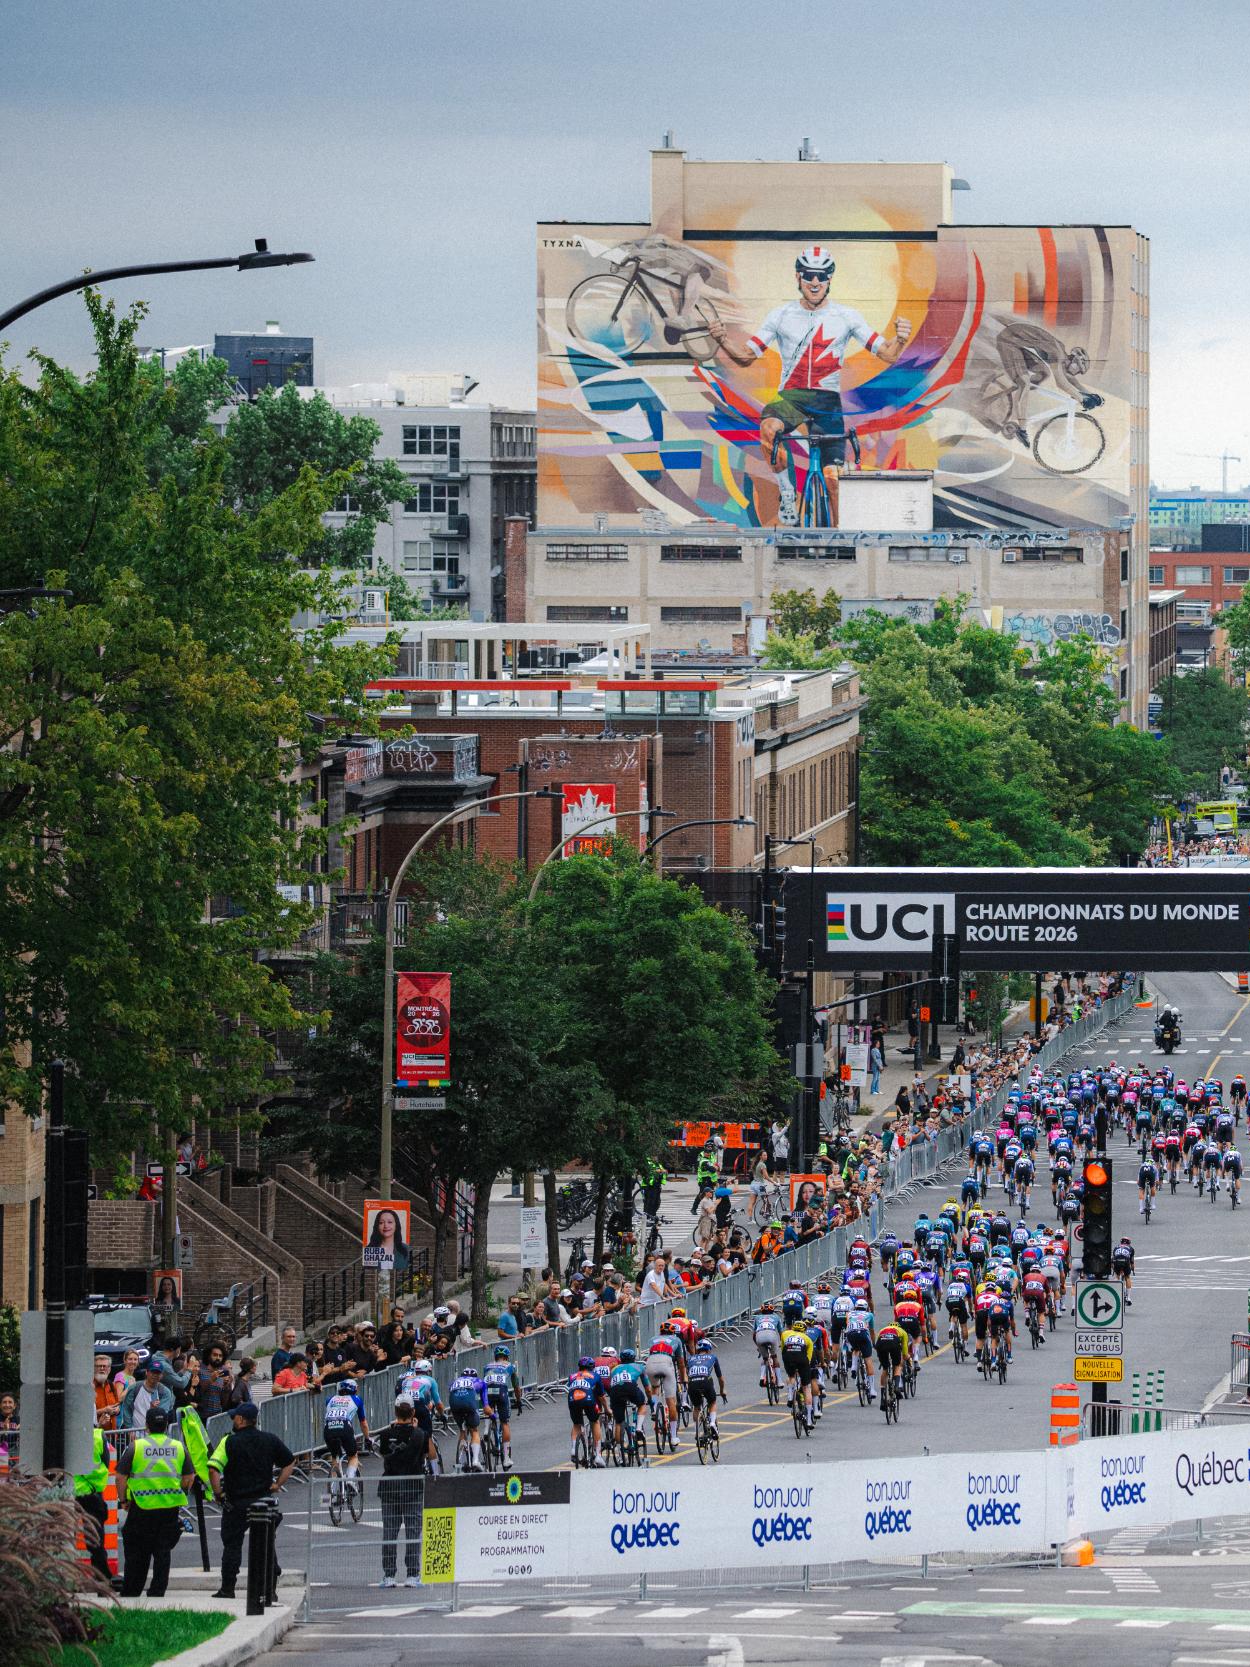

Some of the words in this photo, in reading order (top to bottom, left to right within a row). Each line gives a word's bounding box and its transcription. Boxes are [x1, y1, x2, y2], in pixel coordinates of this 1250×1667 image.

[850, 904, 945, 941] UCI
[965, 903, 1124, 920] CHAMPIONNATS
[1129, 904, 1157, 920] DU
[1163, 904, 1239, 920] MONDE
[966, 925, 1029, 942] ROUTE
[1034, 925, 1078, 942] 2026
[1078, 1333, 1119, 1342] EXCEPTÉ
[1076, 1370, 1121, 1378] SIGNALISATION
[145, 1447, 175, 1457] CADET
[1101, 1455, 1146, 1477] bonjour
[1176, 1451, 1244, 1496] Québec
[866, 1479, 911, 1502] bonjour
[967, 1472, 1020, 1494] bonjour
[612, 1489, 680, 1514] bonjour
[754, 1484, 813, 1508] bonjour
[1101, 1479, 1146, 1512] québec
[478, 1515, 508, 1525] COURSE
[510, 1515, 520, 1525] EN
[522, 1514, 548, 1524] DIRECT
[865, 1506, 911, 1540] québec
[966, 1499, 1021, 1531] québec
[497, 1528, 529, 1540] ÉQUIPES
[611, 1517, 680, 1554] québec
[752, 1513, 812, 1547] québec
[480, 1545, 545, 1556] PROGRAMMATION
